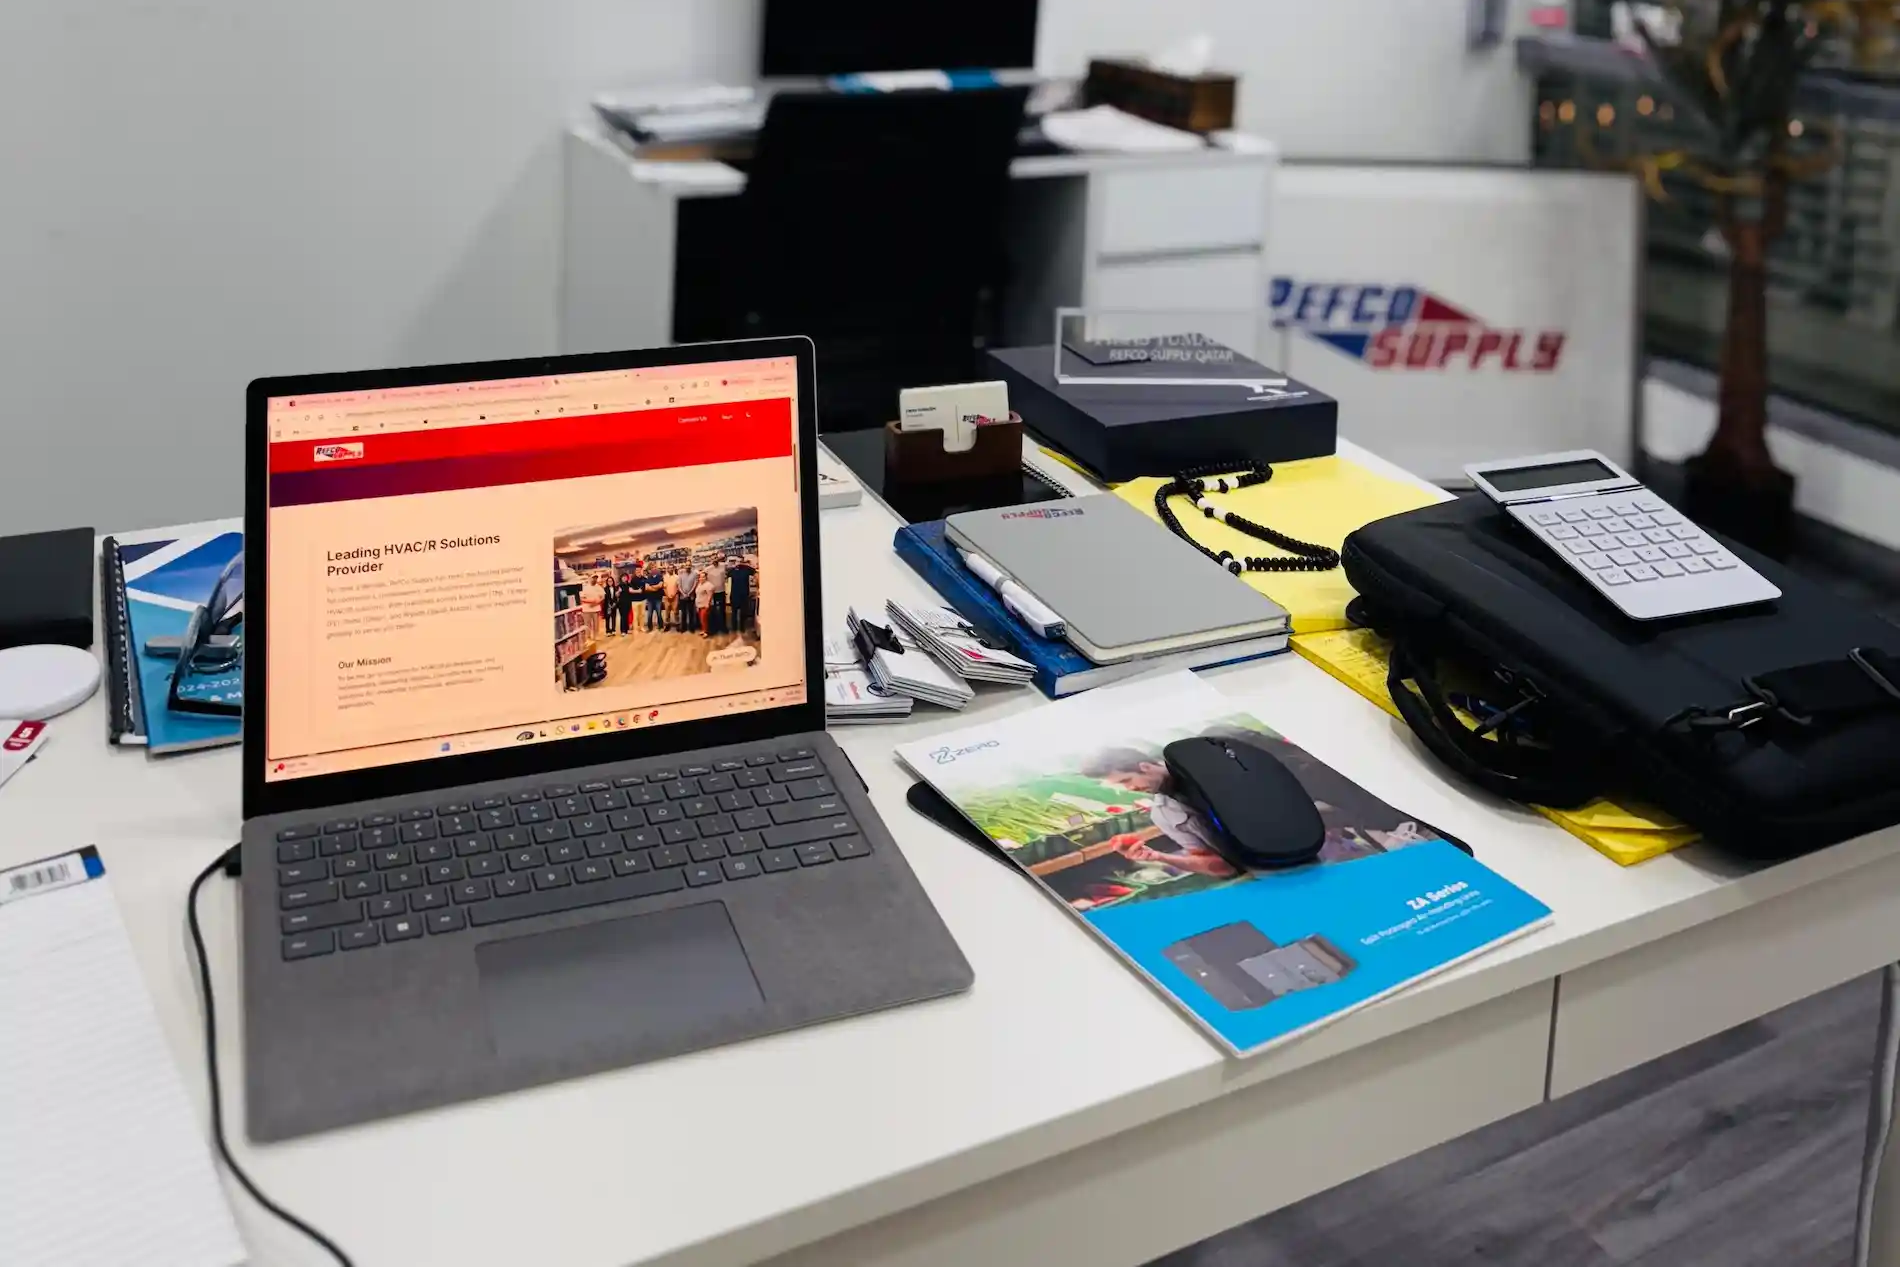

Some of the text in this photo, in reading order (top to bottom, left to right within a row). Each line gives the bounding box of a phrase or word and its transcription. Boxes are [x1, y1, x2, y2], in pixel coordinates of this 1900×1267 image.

[1269, 277, 1419, 328] REFCO
[1366, 327, 1567, 372] SUPPLY
[327, 535, 501, 561] Leading HVAC/R Solutions
[327, 562, 384, 576] Provider
[338, 661, 354, 669] Our
[357, 657, 391, 666] Mission
[951, 740, 1000, 756] ZERO
[1406, 881, 1468, 910] ZA Series
